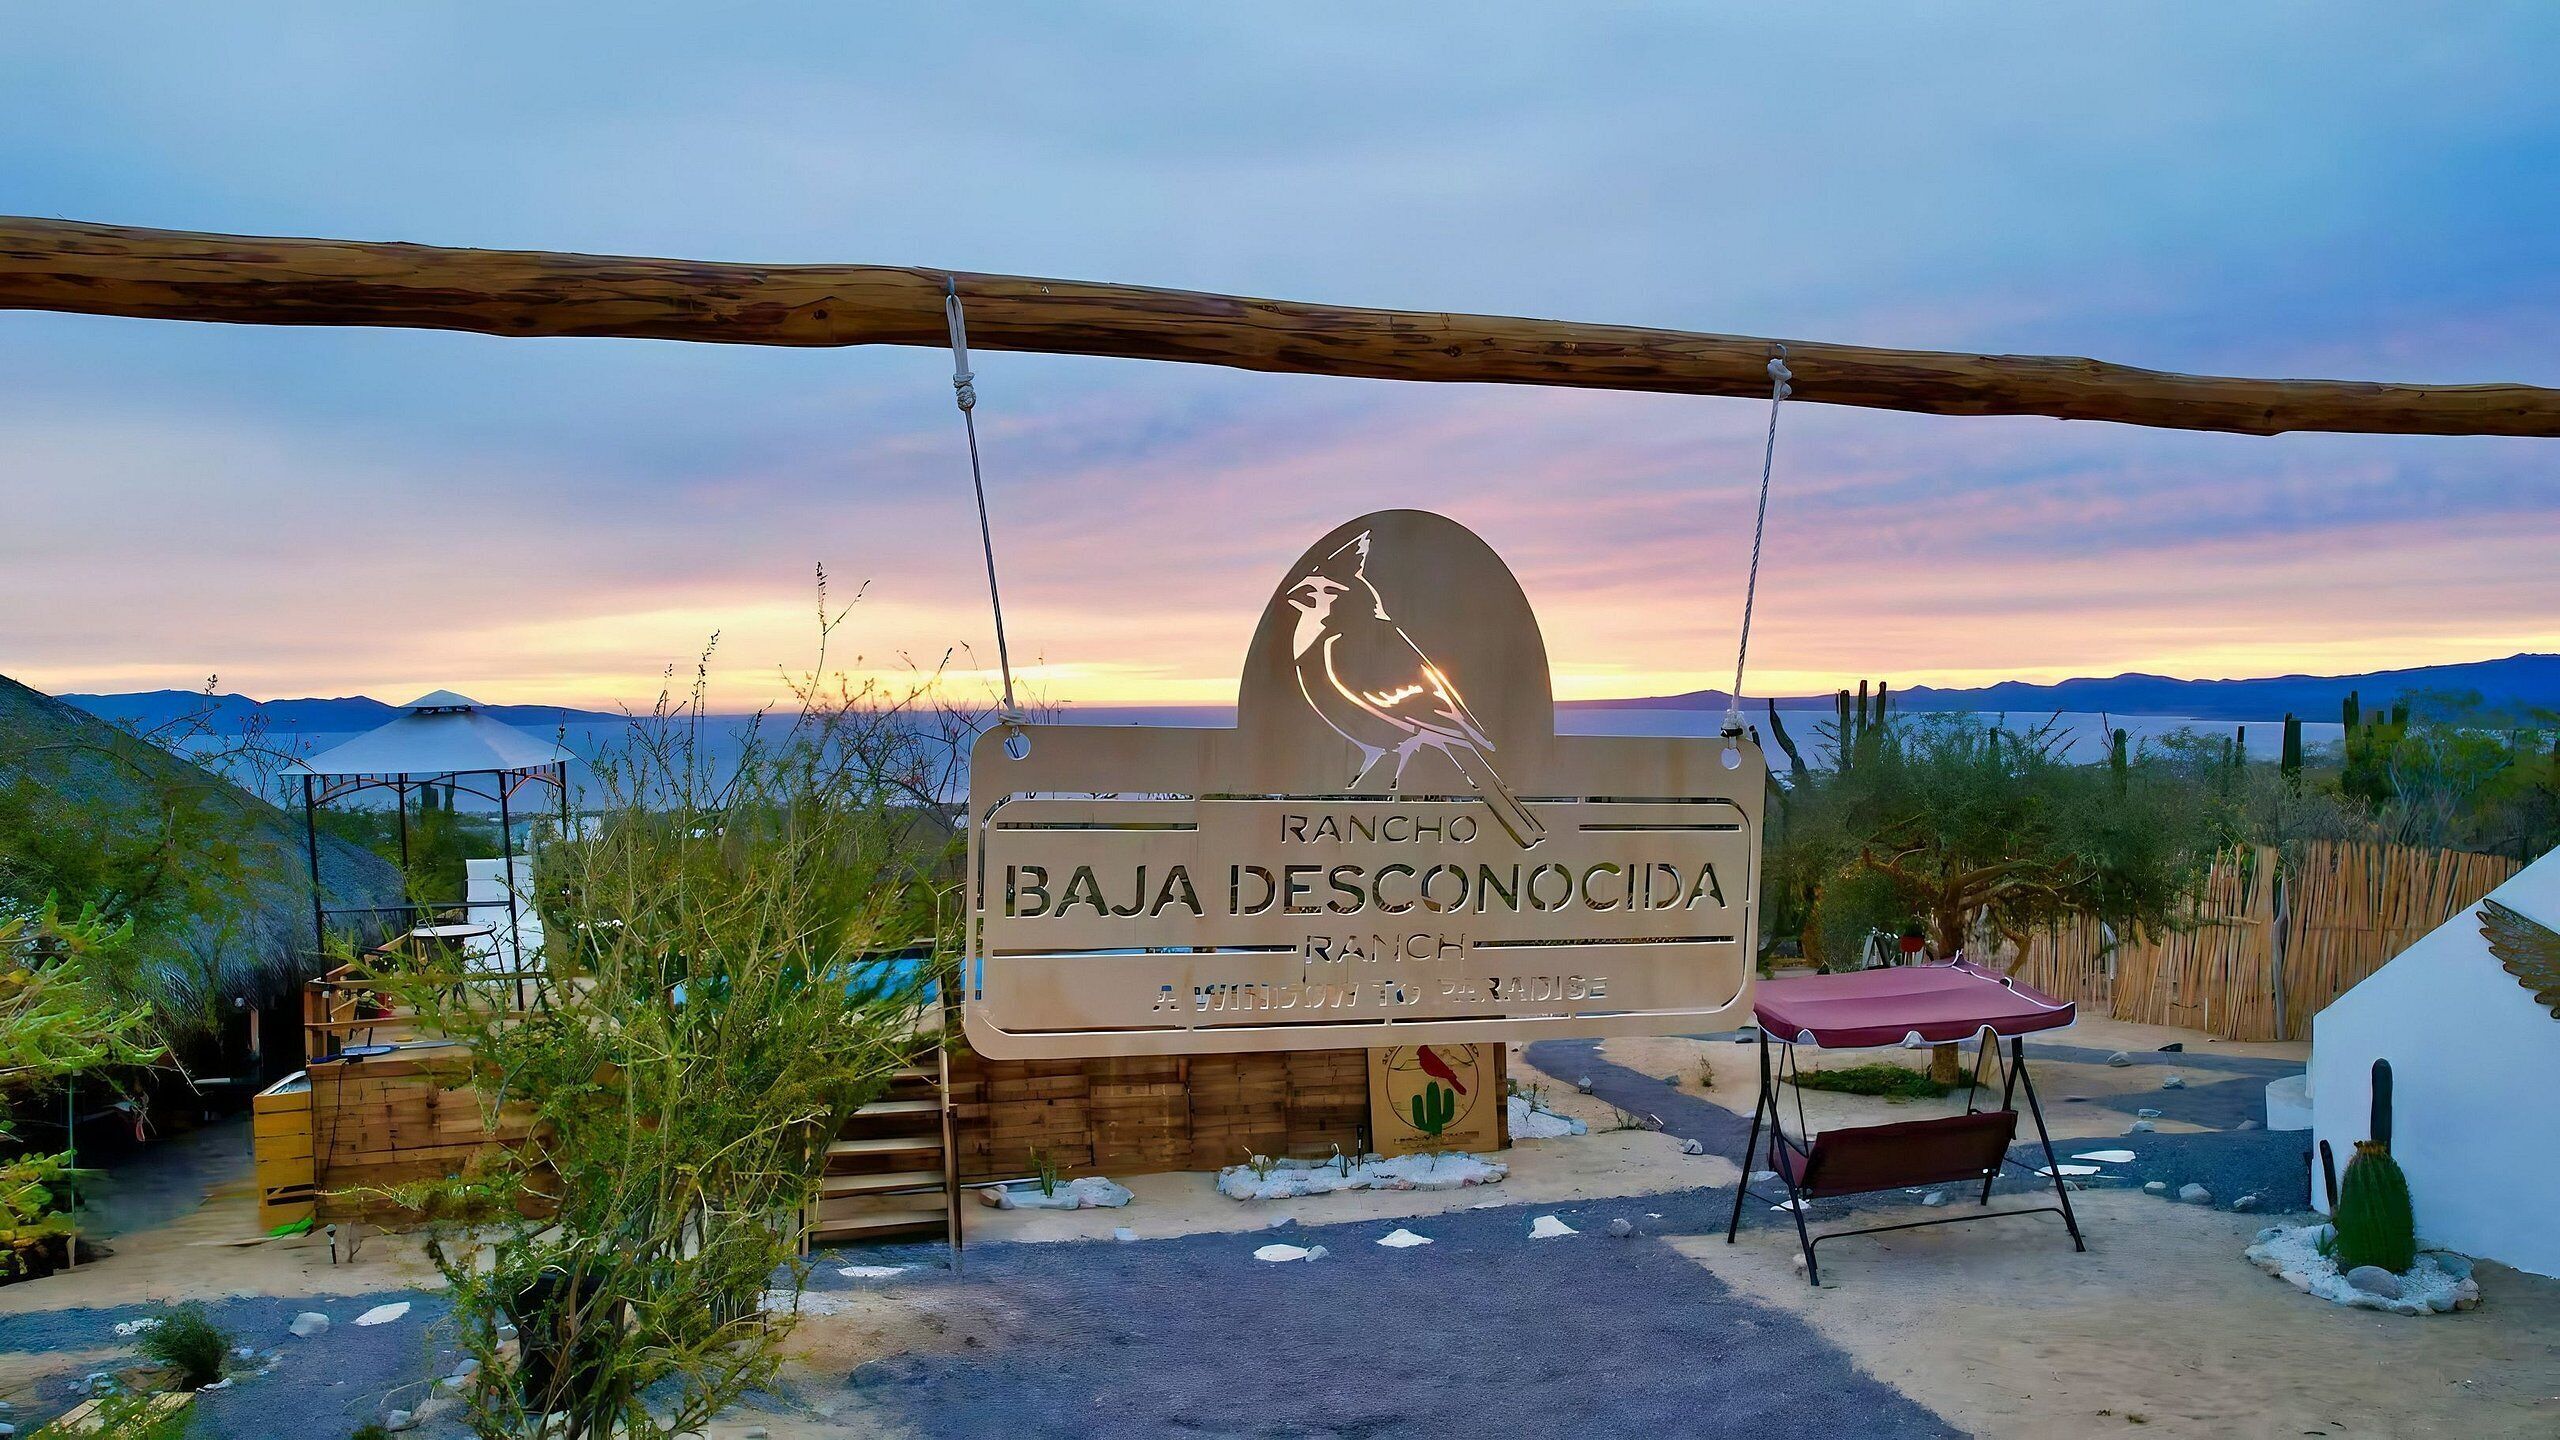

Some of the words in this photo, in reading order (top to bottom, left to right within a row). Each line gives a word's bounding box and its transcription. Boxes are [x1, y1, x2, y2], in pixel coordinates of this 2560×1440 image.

[1281, 814, 1478, 844] RANCHO
[1005, 864, 1205, 918] BAJA
[1229, 862, 1728, 916] DESCONOCIDA
[1305, 932, 1466, 964] RANCH
[1153, 985, 1180, 1012] A
[1194, 983, 1360, 1012] WINDOW
[1372, 979, 1421, 1007] TO
[1437, 974, 1608, 1004] PARADISE
